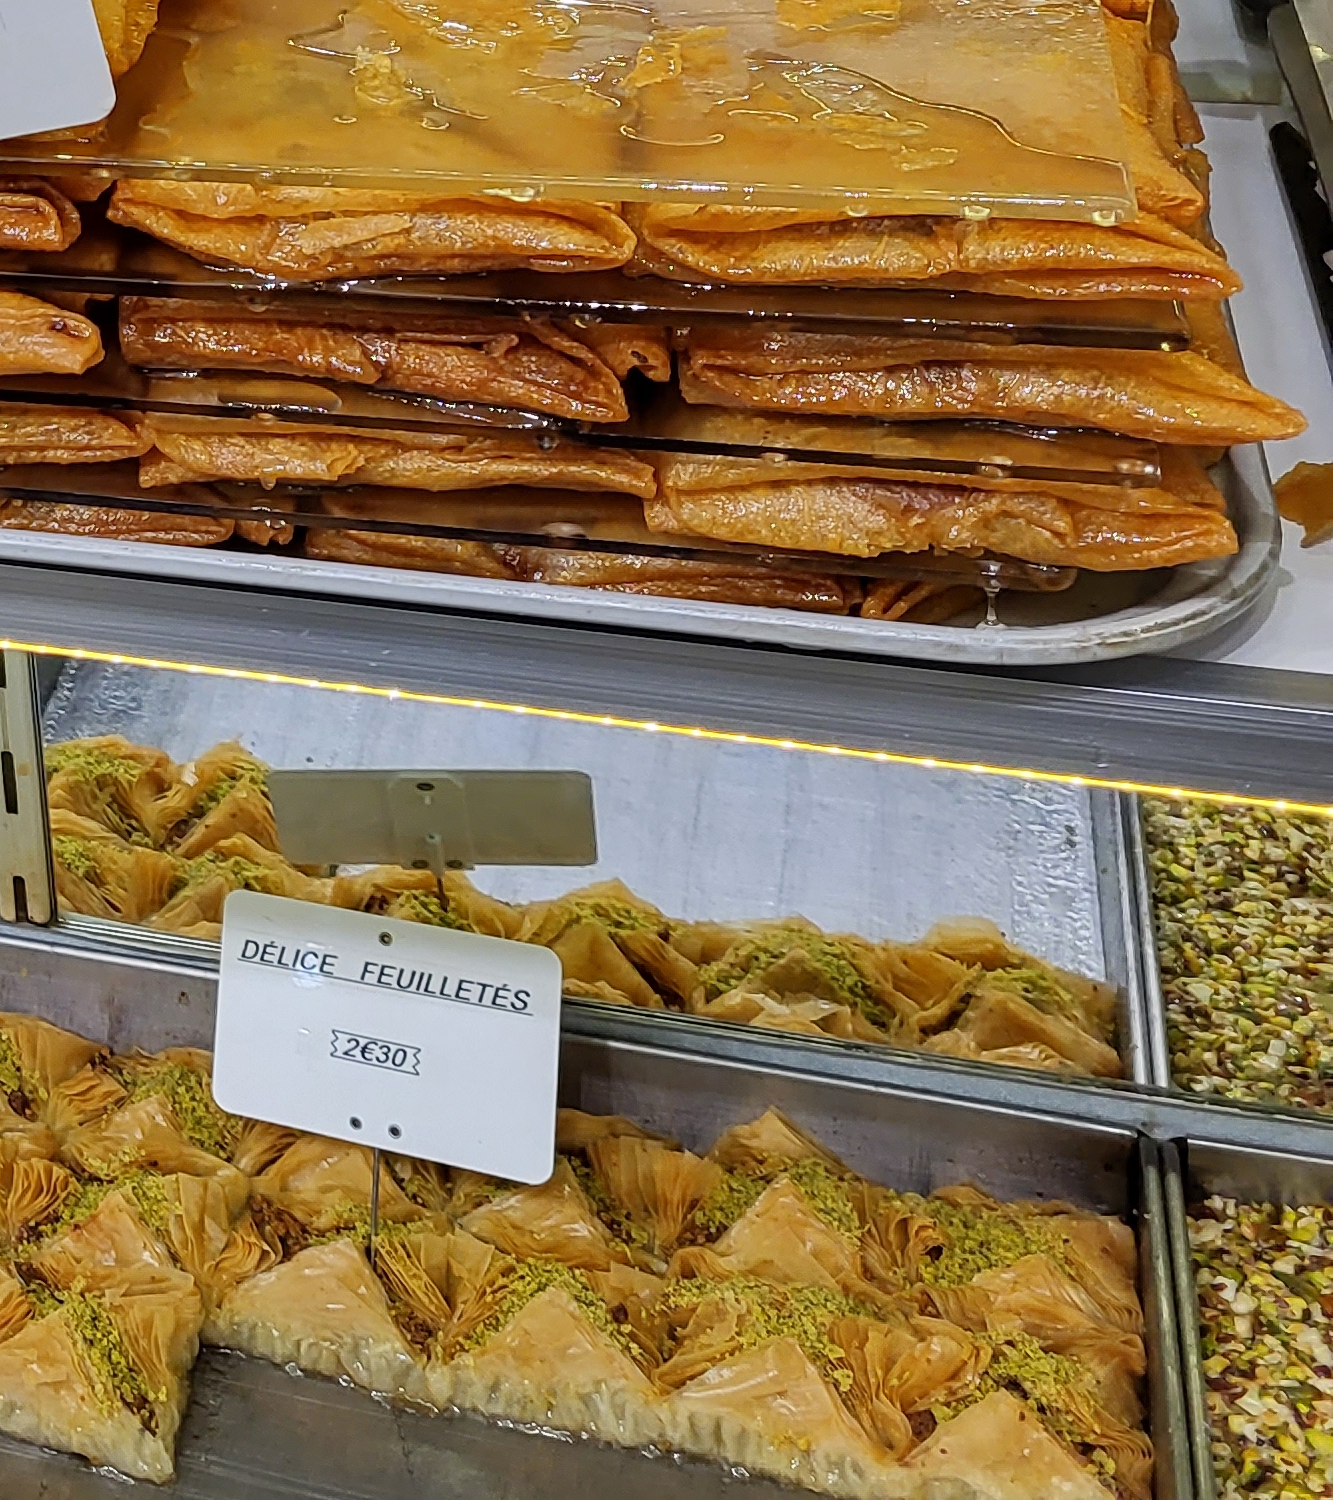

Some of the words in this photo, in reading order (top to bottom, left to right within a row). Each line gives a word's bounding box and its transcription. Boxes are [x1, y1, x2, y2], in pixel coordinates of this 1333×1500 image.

[240, 939, 338, 975] DÉLICE
[360, 961, 532, 1011] FEUILLETÉS
[342, 1037, 408, 1068] 2€30
